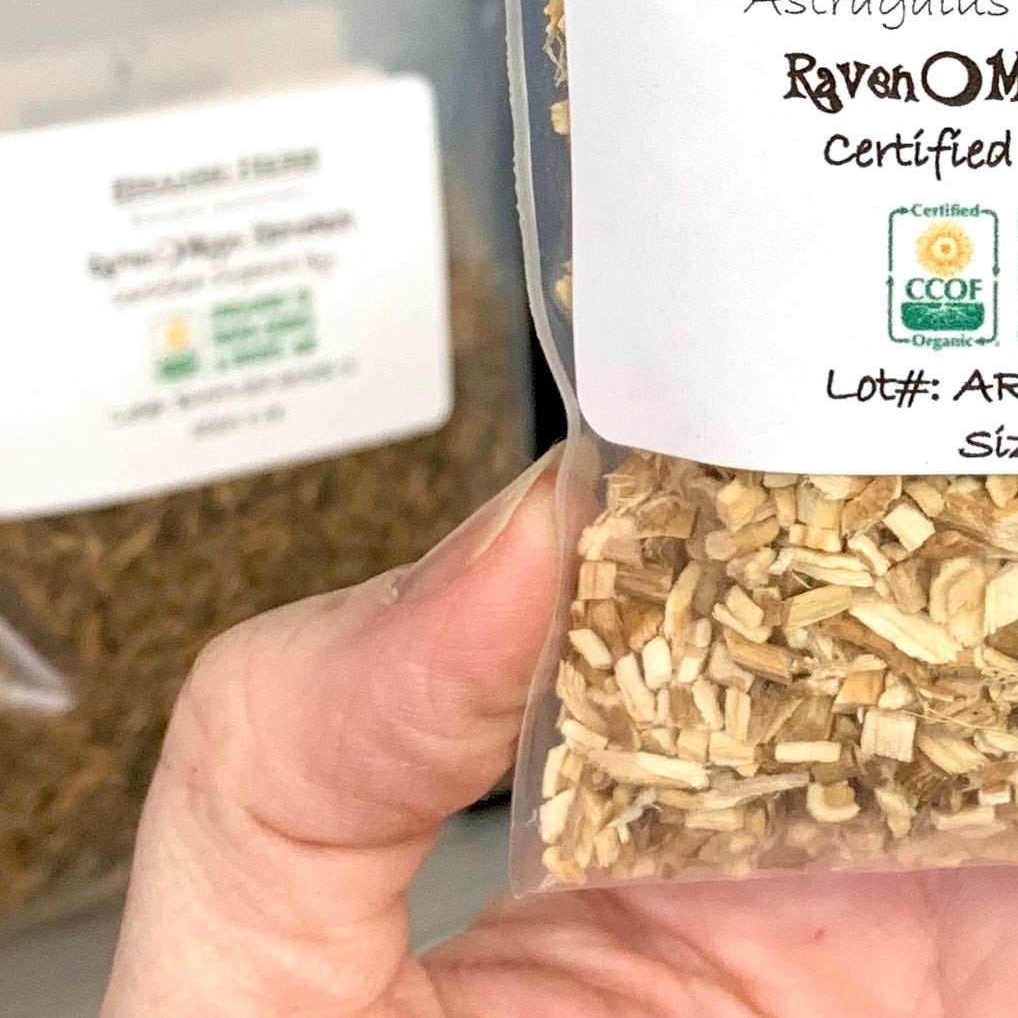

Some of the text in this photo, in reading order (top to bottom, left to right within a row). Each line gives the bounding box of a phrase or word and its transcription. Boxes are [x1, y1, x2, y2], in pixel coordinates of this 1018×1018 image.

[783, 52, 921, 113] Raven
[823, 127, 1013, 181] Certified
[911, 202, 981, 218] Certified
[905, 277, 983, 301] CCOF
[911, 333, 973, 351] Organic
[826, 368, 940, 409] Lot#:
